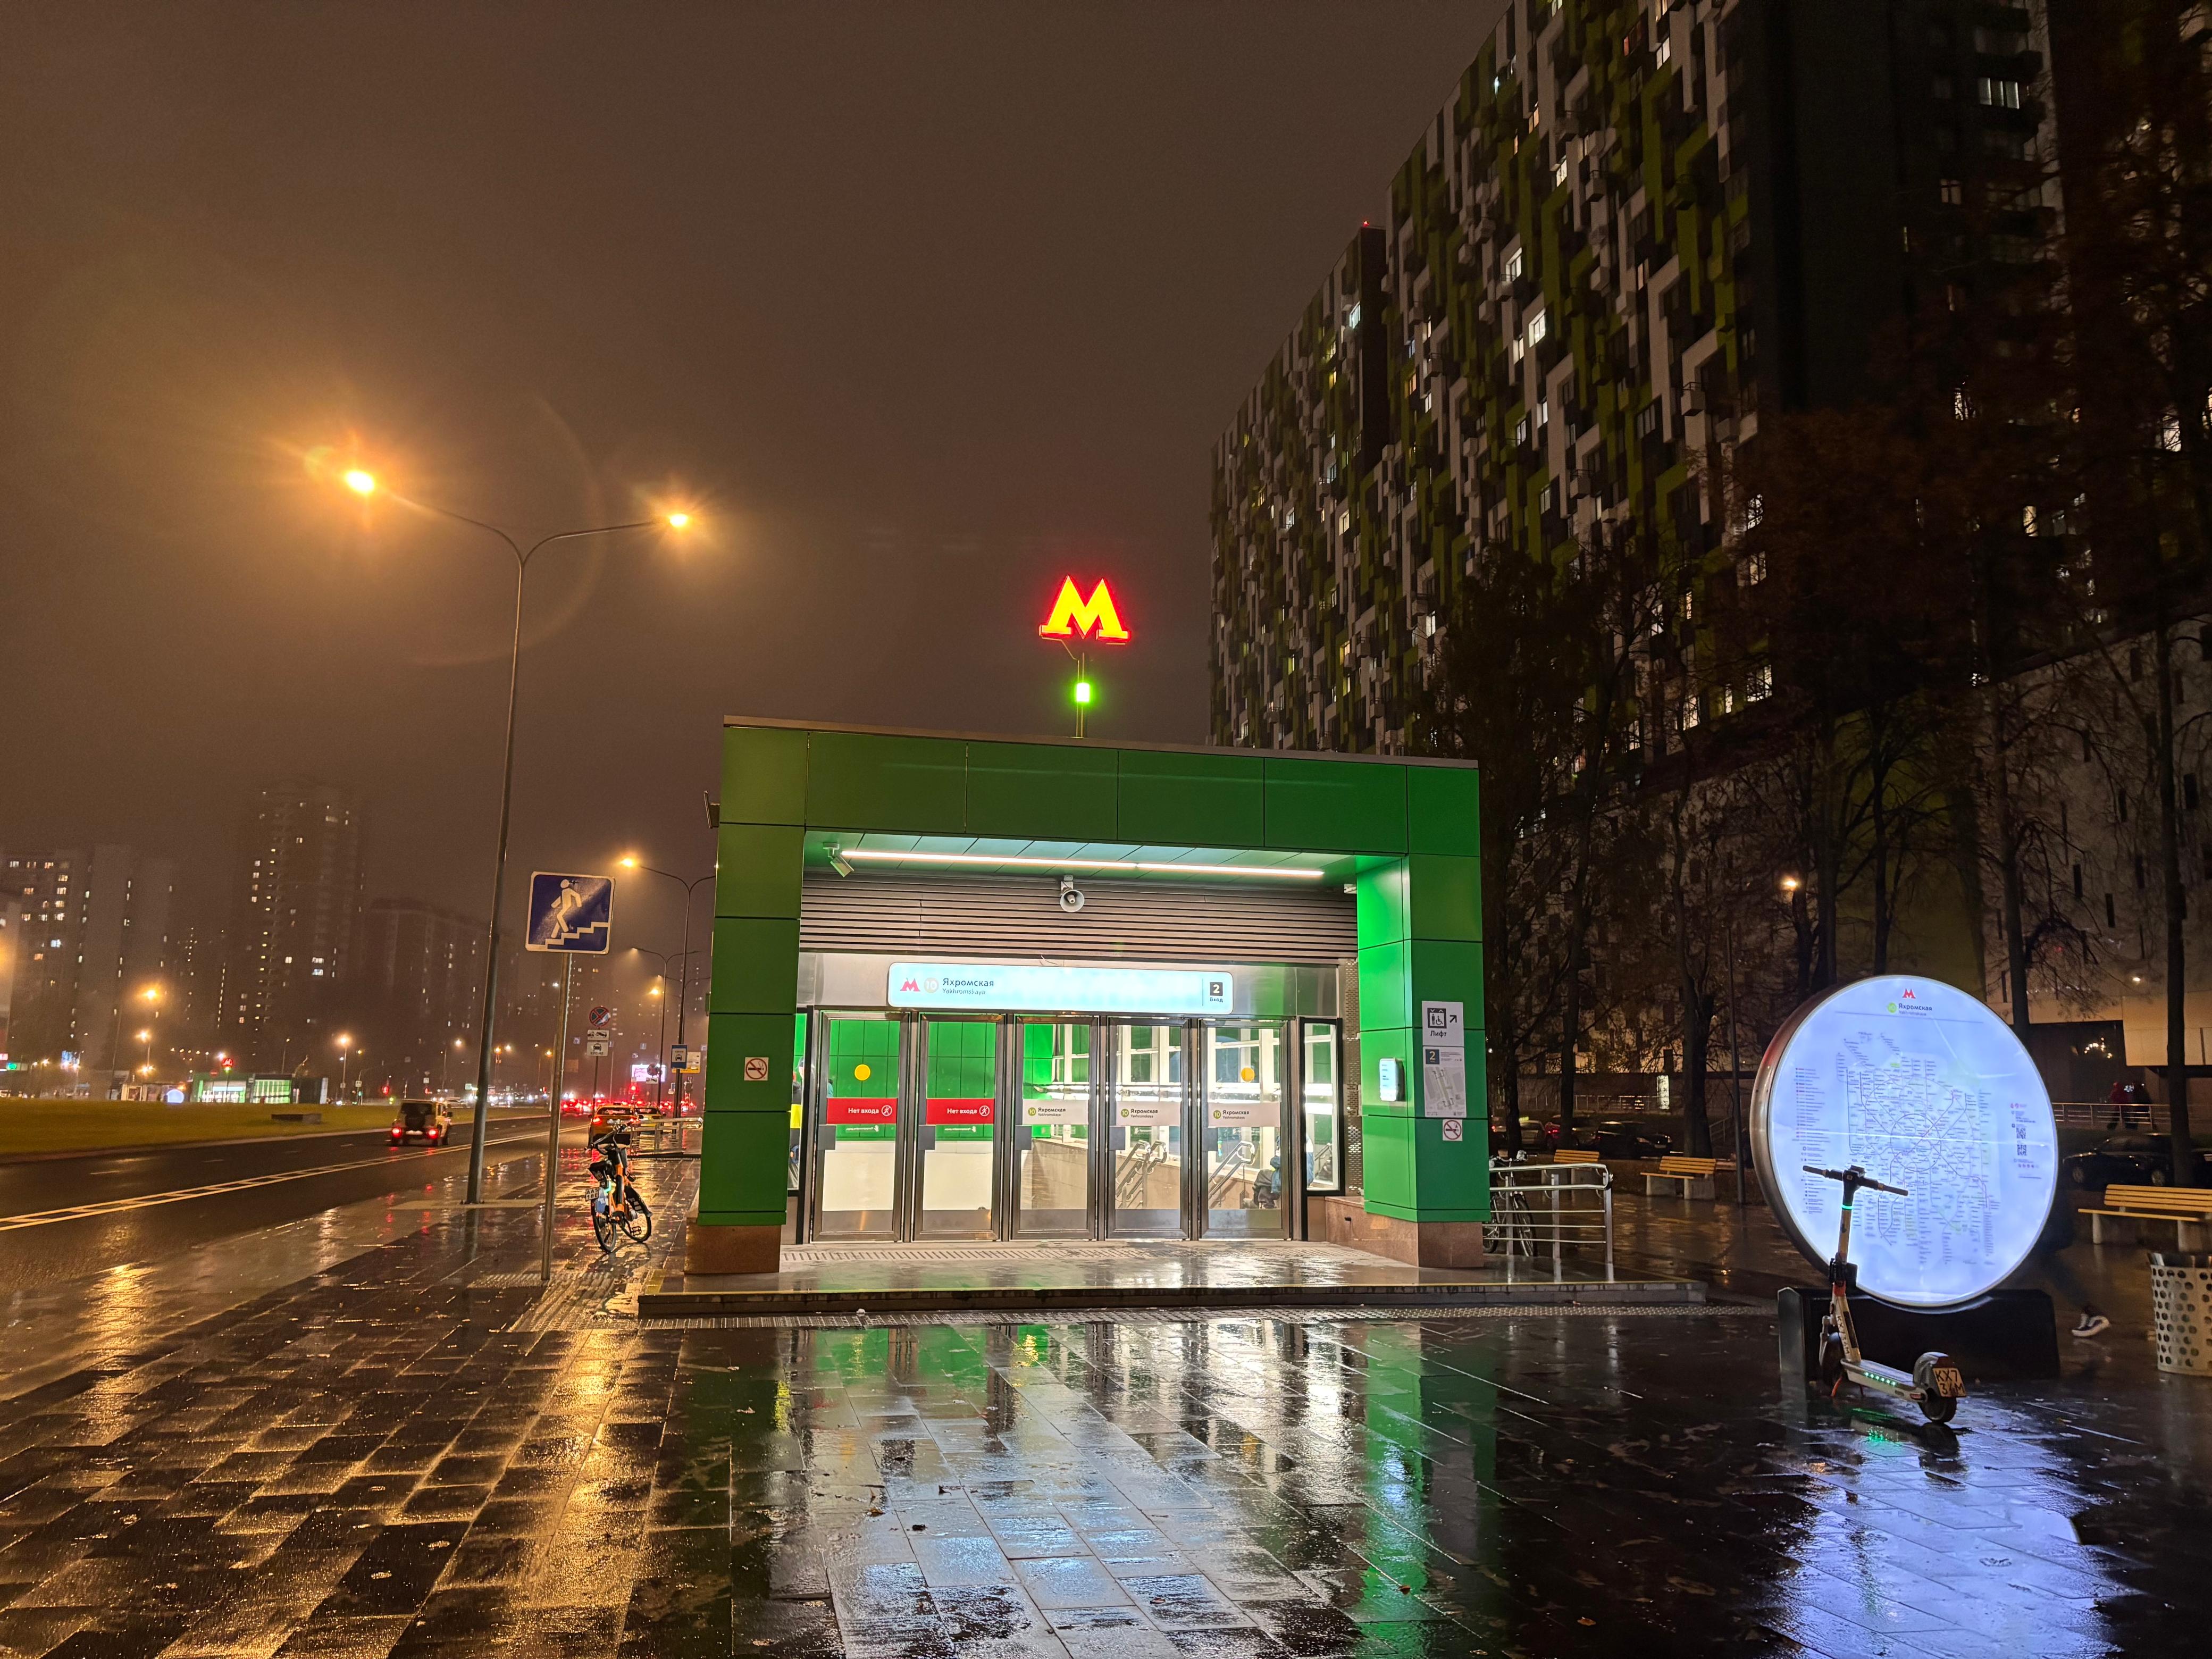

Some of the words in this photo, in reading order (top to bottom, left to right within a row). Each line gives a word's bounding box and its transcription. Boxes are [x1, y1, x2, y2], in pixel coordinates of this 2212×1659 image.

[943, 978, 994, 987] Яхромская
[1213, 984, 1220, 993] 2
[1429, 1051, 1436, 1060] 2
[1935, 1369, 1957, 1382] KX7
